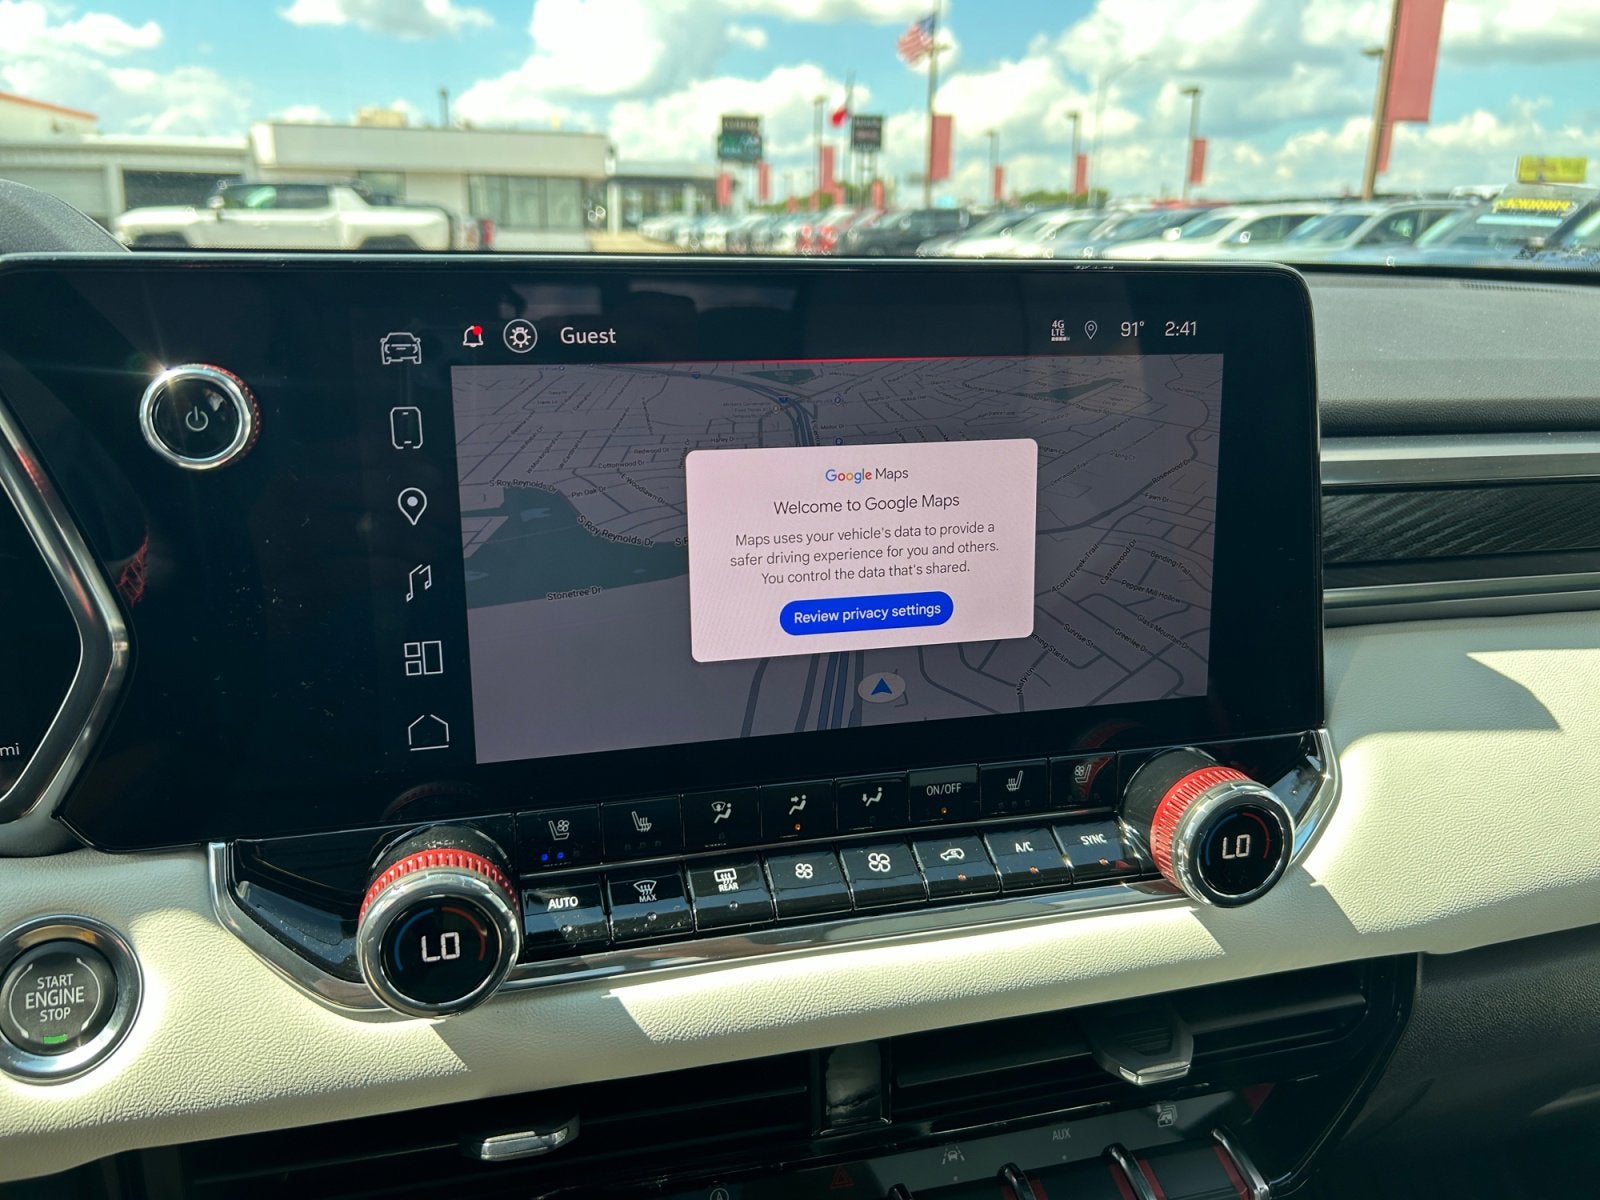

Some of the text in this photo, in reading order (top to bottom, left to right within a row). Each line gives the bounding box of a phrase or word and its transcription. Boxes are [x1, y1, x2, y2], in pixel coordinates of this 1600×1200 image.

[1051, 319, 1065, 329] 4G
[1051, 328, 1065, 337] LTE
[1165, 321, 1197, 337] 2:41
[560, 326, 617, 344] Guest
[825, 467, 909, 484] Google Maps
[1151, 458, 1191, 484] Rosewood Dr
[496, 480, 511, 489] Roy
[513, 479, 546, 489] Reynolds
[549, 485, 557, 493] Dr
[584, 488, 597, 496] Oak
[626, 477, 658, 500] Woodlawn
[657, 496, 666, 505] Dr
[774, 494, 960, 515] Welcome to Google Maps
[579, 515, 654, 547] S Roy Reynolds Dr
[735, 522, 995, 548] Maps uses your vehicle's data to provide a
[675, 537, 682, 546] S
[730, 540, 999, 567] safer driving experience for you and others.
[1099, 538, 1137, 586] Castlewood Dr
[1051, 576, 1071, 593] Acorn
[1085, 543, 1100, 560] Trail
[1150, 550, 1191, 576] Bending Trail
[761, 561, 971, 585] You control the data that's shared.
[547, 585, 602, 601] Stonetree Dr
[1121, 579, 1145, 592] Pepper
[794, 603, 942, 625] Review privacy settings
[1063, 623, 1095, 649] Sunrise St
[1048, 645, 1061, 658] Star
[1060, 654, 1070, 664] Ln
[1016, 667, 1035, 695] Misty Ln
[0, 742, 20, 756] mi
[925, 782, 962, 796] ON/OFF
[1015, 840, 1034, 853] A/C
[1080, 833, 1107, 846] SYNC
[1221, 833, 1251, 860] LO
[718, 882, 738, 892] REAR
[547, 896, 579, 911] AUTO
[639, 893, 657, 903] MAX
[420, 931, 461, 963] LO
[37, 973, 74, 990] START
[25, 986, 85, 1010] ENGINE
[39, 1006, 72, 1022] STOP
[1052, 1127, 1072, 1141] AUX
